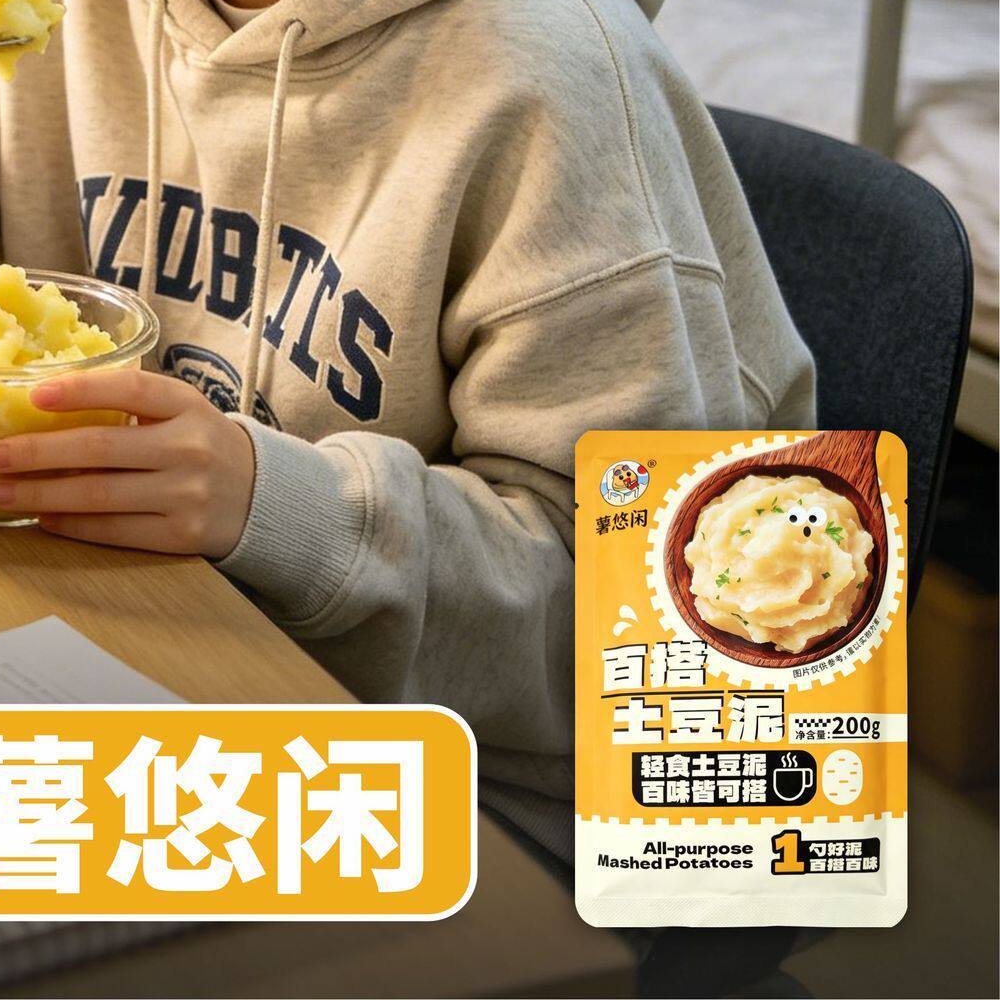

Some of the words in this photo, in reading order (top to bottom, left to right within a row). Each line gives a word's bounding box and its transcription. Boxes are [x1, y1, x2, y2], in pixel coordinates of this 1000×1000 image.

[596, 509, 648, 535] 薯悠闲
[602, 640, 708, 691] 百搭
[612, 693, 785, 744] 土豆泥
[832, 716, 881, 740] 200g
[640, 753, 767, 778] 轻食土豆泥
[640, 779, 767, 804] 百味皆可搭
[597, 854, 662, 870] Mashed
[665, 858, 754, 870] Potatoes
[643, 841, 754, 858] All-purpose
[772, 830, 805, 874] 1
[808, 841, 863, 857] 勺好泥
[809, 856, 878, 872] 百搭百味
